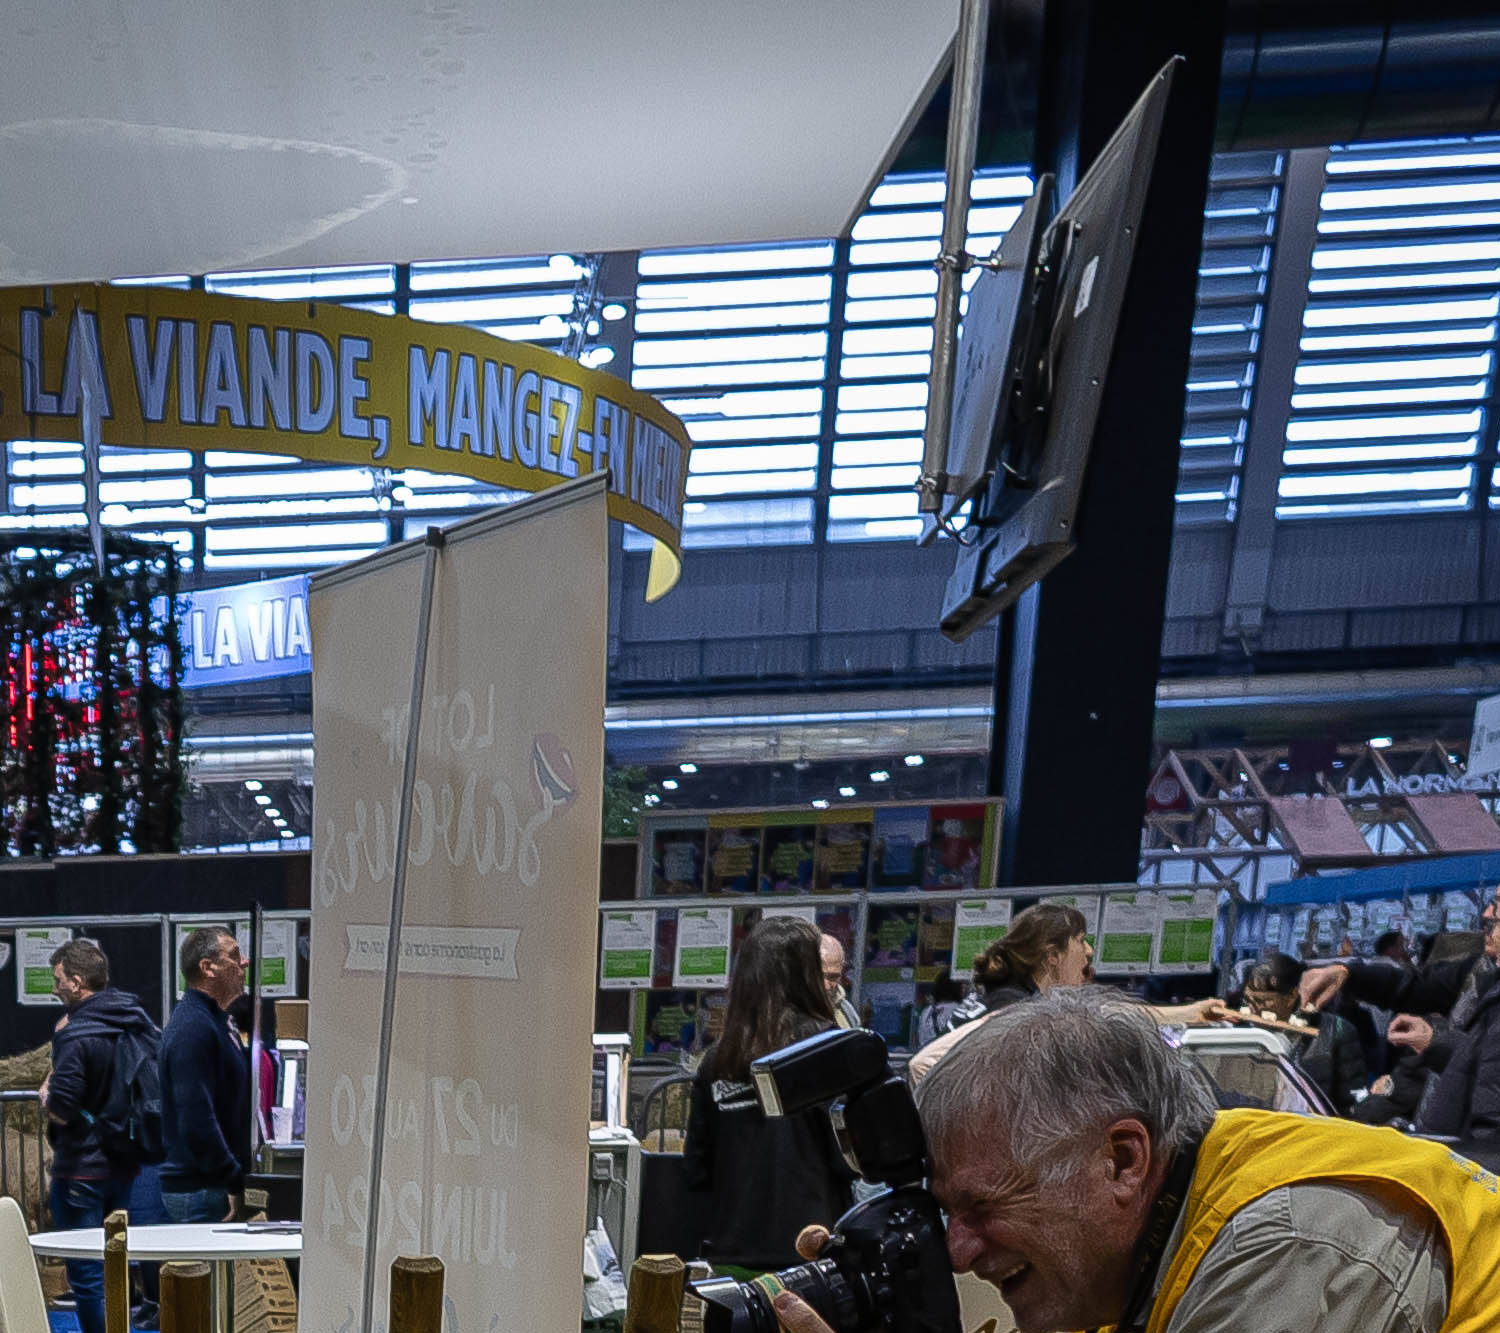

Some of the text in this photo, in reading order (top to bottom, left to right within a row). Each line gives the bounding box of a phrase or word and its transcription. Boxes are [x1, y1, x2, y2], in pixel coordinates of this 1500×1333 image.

[20, 308, 113, 420] LA
[126, 315, 390, 460] VIANDE,
[407, 344, 630, 496] MANGEZ-EN
[192, 605, 244, 670] LA
[1346, 775, 1382, 798] LA
